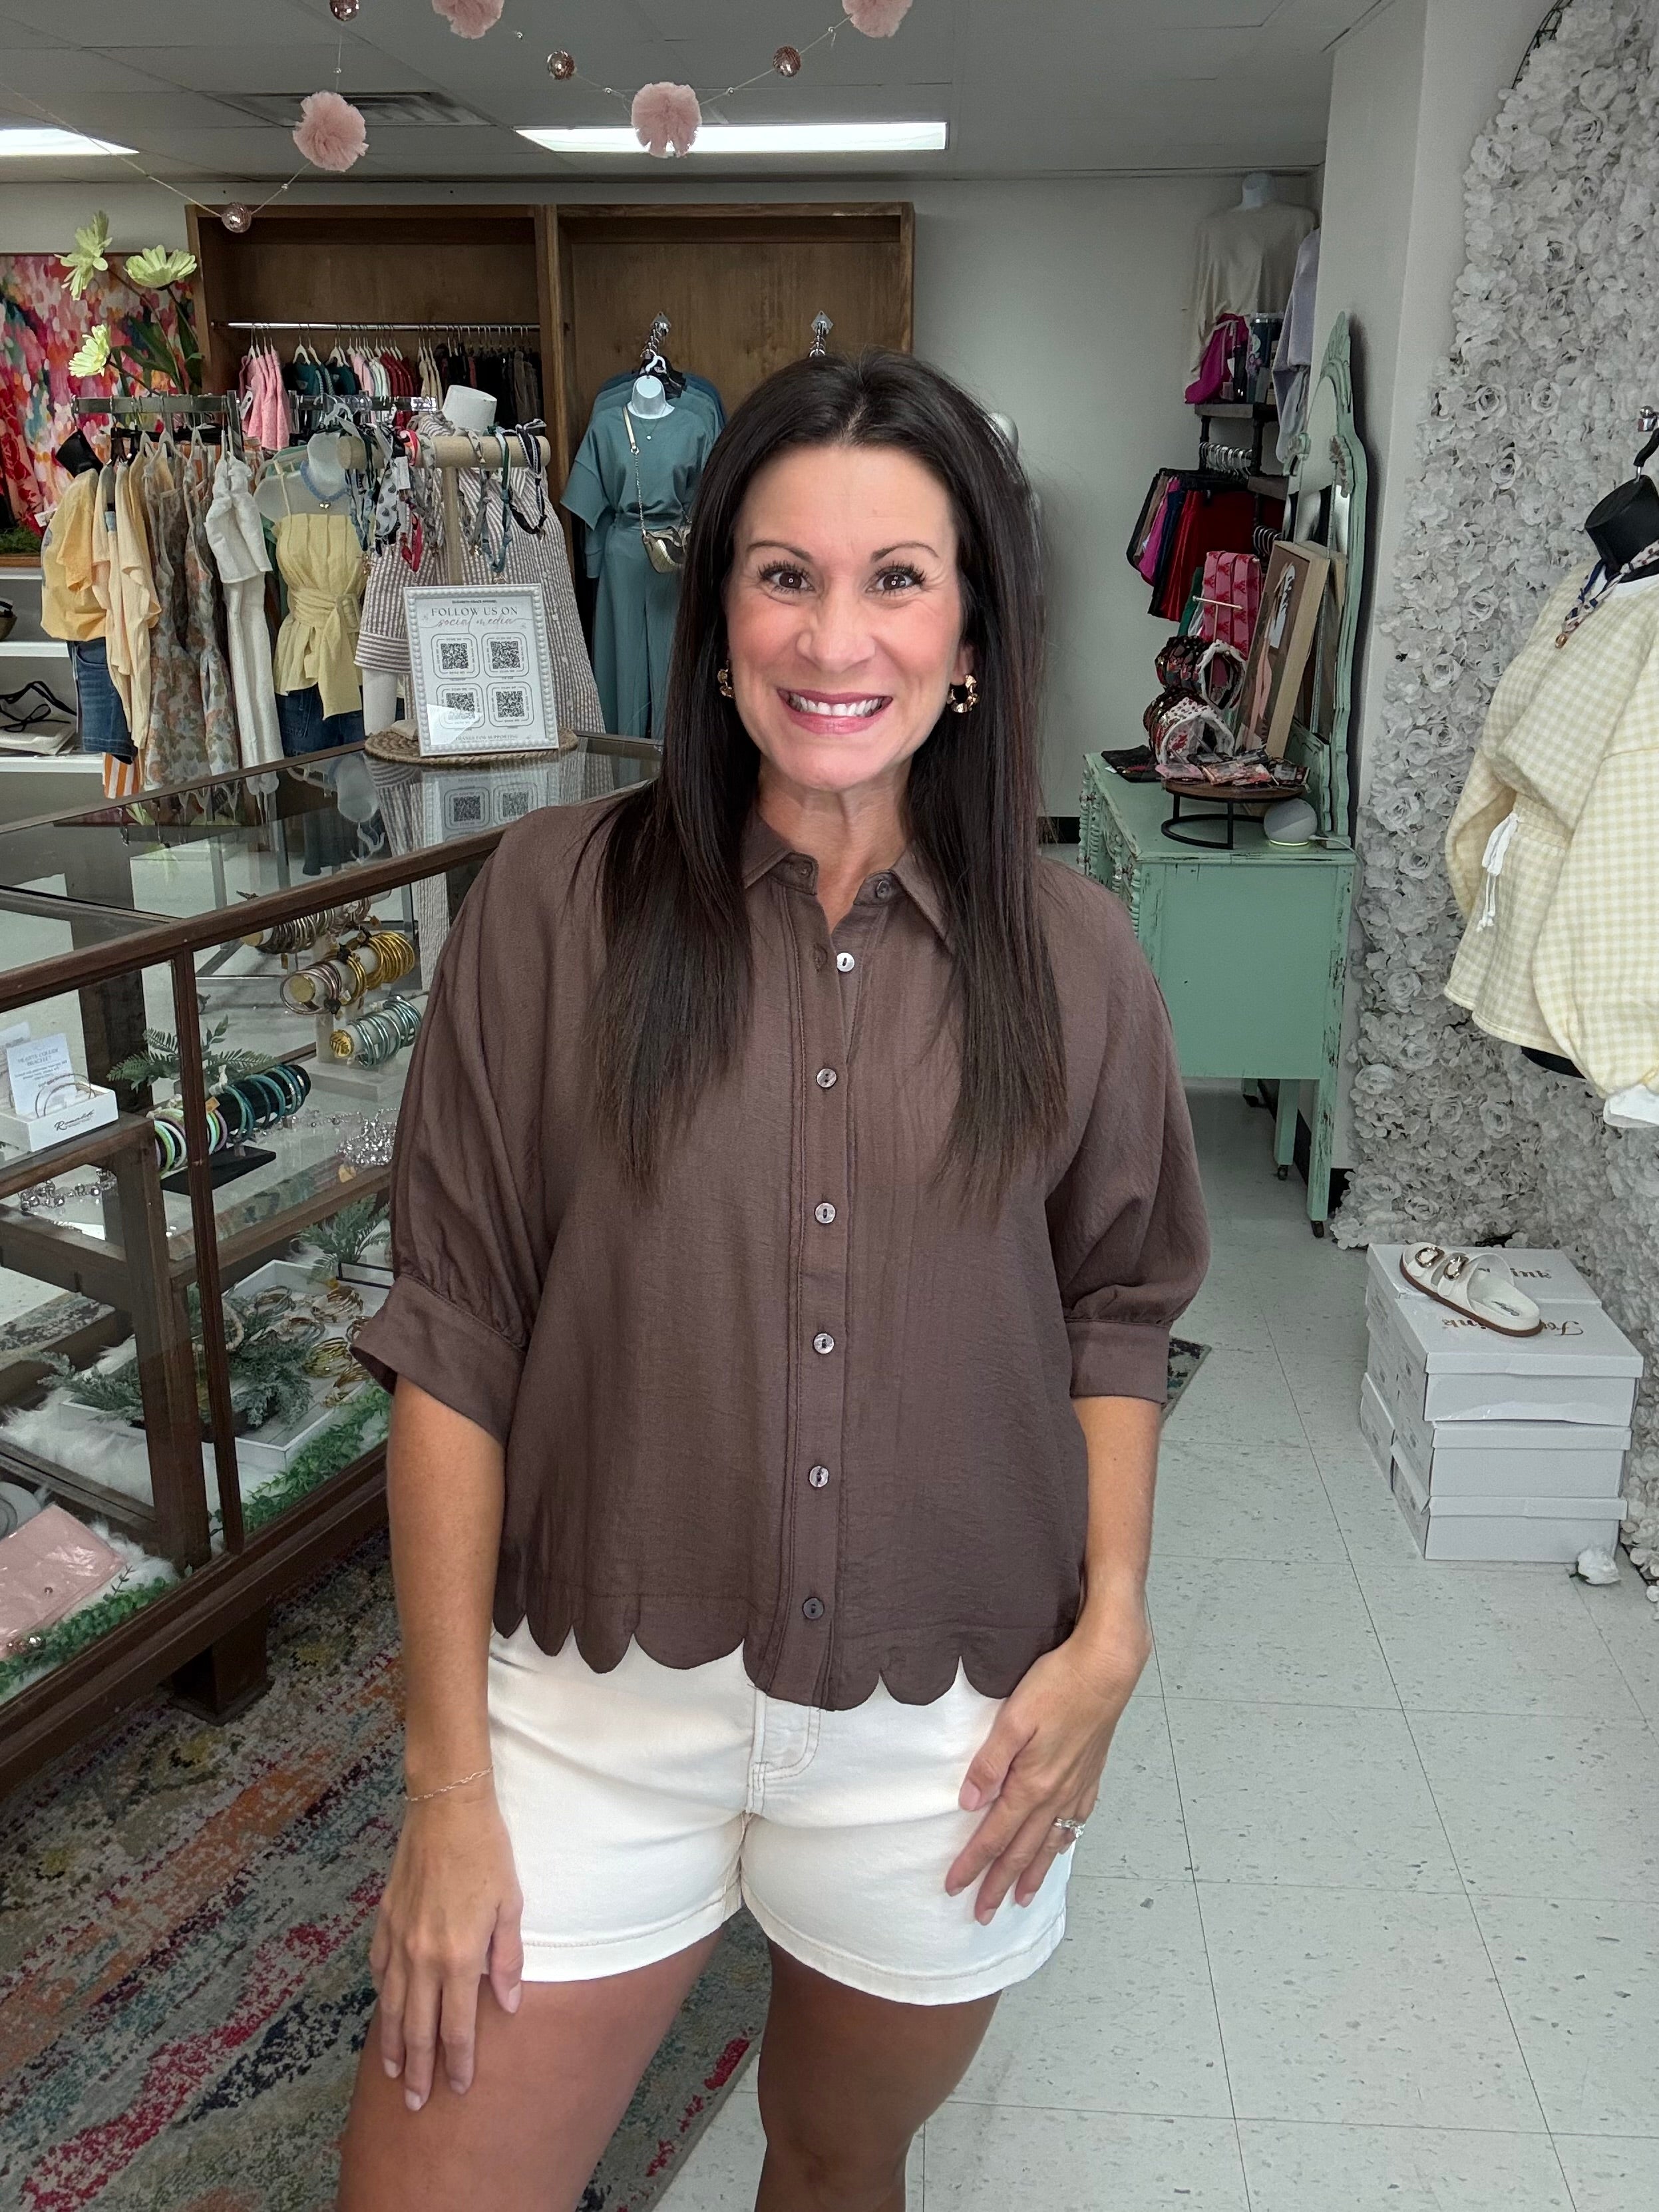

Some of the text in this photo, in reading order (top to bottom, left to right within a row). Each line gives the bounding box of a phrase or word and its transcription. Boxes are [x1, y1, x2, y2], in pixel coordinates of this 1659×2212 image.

[431, 606, 518, 616] FOLLOW US ON
